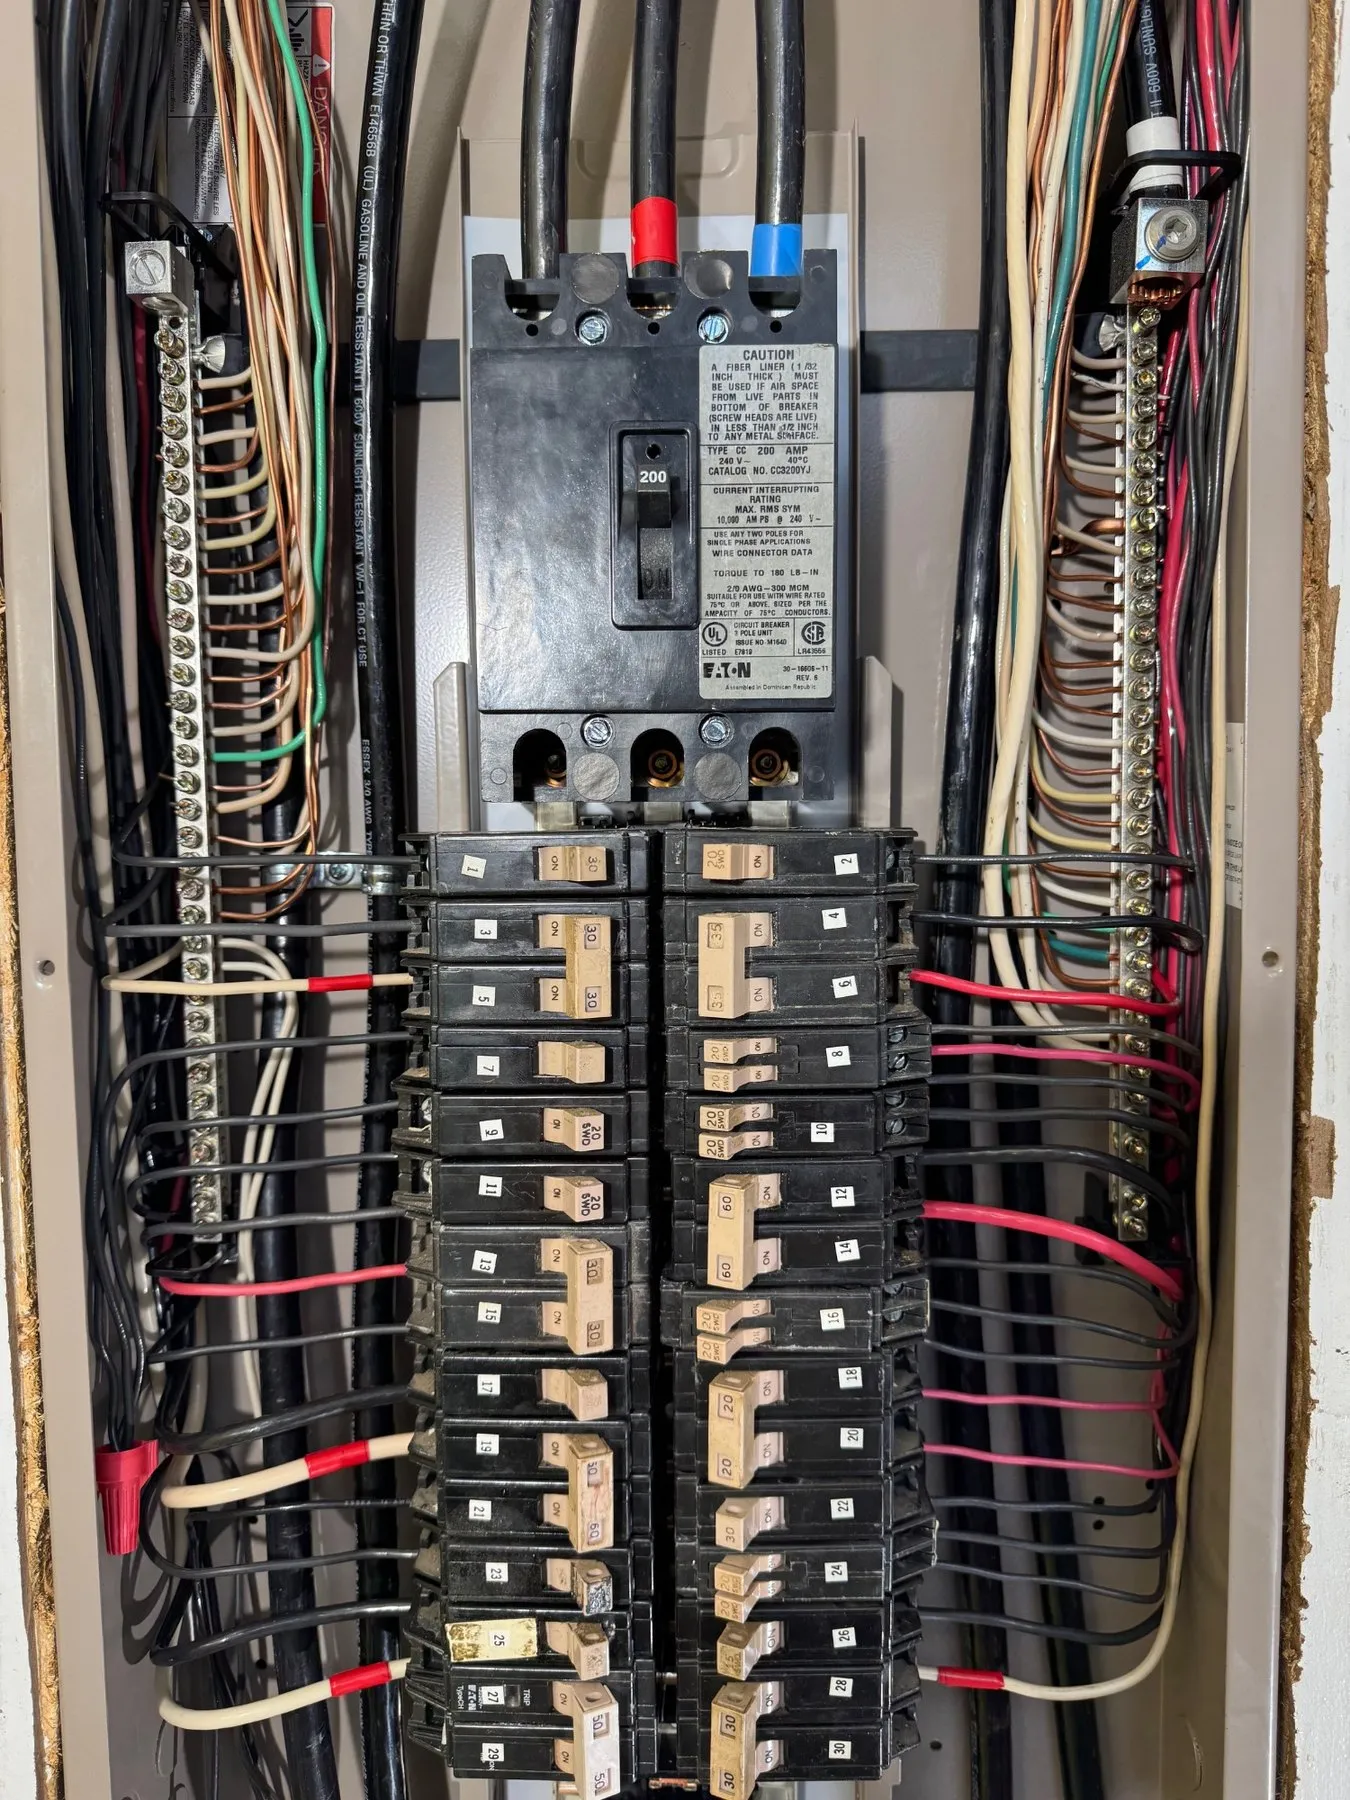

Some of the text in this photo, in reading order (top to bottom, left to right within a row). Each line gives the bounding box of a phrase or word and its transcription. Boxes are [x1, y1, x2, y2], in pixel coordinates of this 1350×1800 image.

[1146, 62, 1160, 92] 600V
[353, 35, 388, 667] OR THWN (UL) GASOLINE AND OIL RESISTANT 600V SUNLIGHT RESISTANT VW-1 FOR CT USE
[743, 350, 794, 360] CAUTION
[760, 363, 785, 371] LINER
[712, 383, 722, 391] BE
[709, 415, 741, 423] (SCREW
[796, 413, 817, 421] LIVE)
[712, 424, 719, 432] IN
[708, 447, 727, 455] TYPE
[709, 466, 810, 475] CATALOG NO. CC3200YJ
[640, 471, 667, 483] 200
[782, 505, 800, 513] SYM
[790, 515, 802, 523] 240
[703, 662, 750, 678] EATON
[362, 739, 372, 824] ESSEX 3/0 AWG
[588, 856, 597, 872] 30
[707, 851, 717, 867] 20
[587, 926, 596, 942] 30
[588, 992, 596, 1009] 30
[712, 1047, 719, 1060] 20
[712, 1075, 720, 1088] 20
[707, 1111, 716, 1126] 20
[582, 1123, 590, 1145] SWD
[592, 1126, 600, 1139] 20
[816, 1124, 827, 1135] 10
[707, 1140, 716, 1155] 20
[485, 1183, 497, 1194] 11
[836, 1189, 846, 1200] 12
[581, 1194, 590, 1216] SWD
[591, 1196, 600, 1210] 20
[722, 1197, 731, 1211] 60
[841, 1243, 852, 1253] 14
[480, 1258, 492, 1271] 13
[722, 1263, 730, 1277] 60
[485, 1309, 496, 1320] 15
[702, 1313, 711, 1328] 20
[828, 1312, 839, 1323] 16
[703, 1344, 711, 1358] 20
[846, 1369, 857, 1380] 18
[482, 1381, 493, 1392] 17
[724, 1395, 733, 1412] 20
[848, 1430, 859, 1441] 20
[481, 1441, 492, 1452] 19
[722, 1458, 731, 1476] 20
[838, 1499, 849, 1512] 22
[474, 1507, 484, 1517] 21
[726, 1527, 734, 1542] 30
[491, 1568, 502, 1580] 23
[832, 1565, 842, 1576] 24
[494, 1635, 504, 1646] 25
[839, 1630, 850, 1642] 26
[835, 1680, 846, 1692] 28
[488, 1692, 498, 1703] 27
[593, 1715, 602, 1730] 50
[726, 1716, 736, 1732] 30
[488, 1748, 499, 1760] 29
[834, 1743, 845, 1755] 30
[725, 1773, 734, 1789] 30
